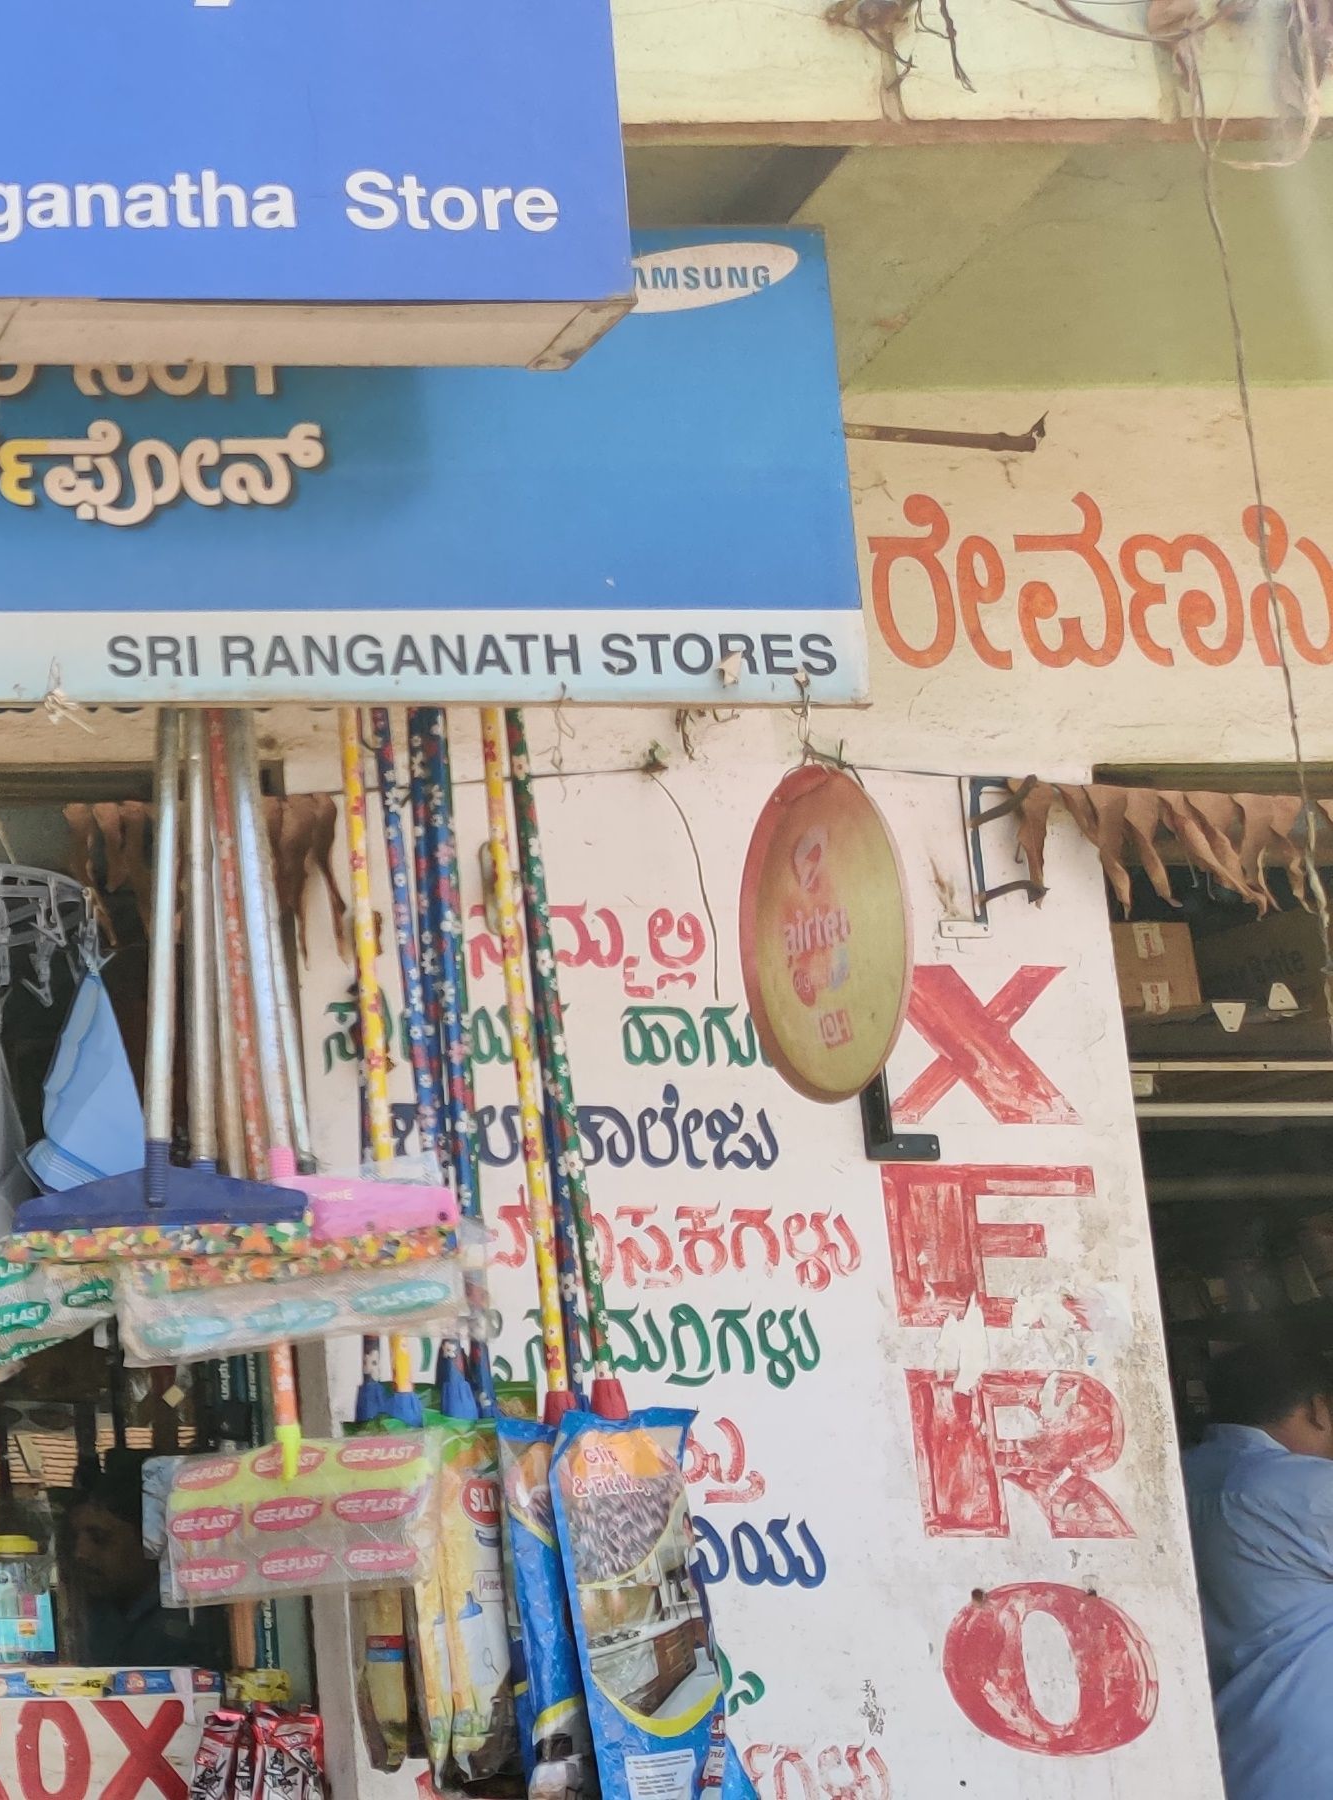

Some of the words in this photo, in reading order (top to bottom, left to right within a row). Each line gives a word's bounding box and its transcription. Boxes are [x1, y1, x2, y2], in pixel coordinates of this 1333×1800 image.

[344, 169, 559, 232] Store
[107, 636, 199, 678] SRI
[220, 633, 580, 678] RANGANATH
[601, 633, 837, 677] STORES
[341, 1445, 415, 1463] GEE-PLAST
[253, 1504, 316, 1524] GEE-PLAST
[336, 1497, 409, 1514] GEE-PLAST
[172, 1513, 234, 1533] GEE-PLAST
[262, 1554, 326, 1575] GEE-PLAST
